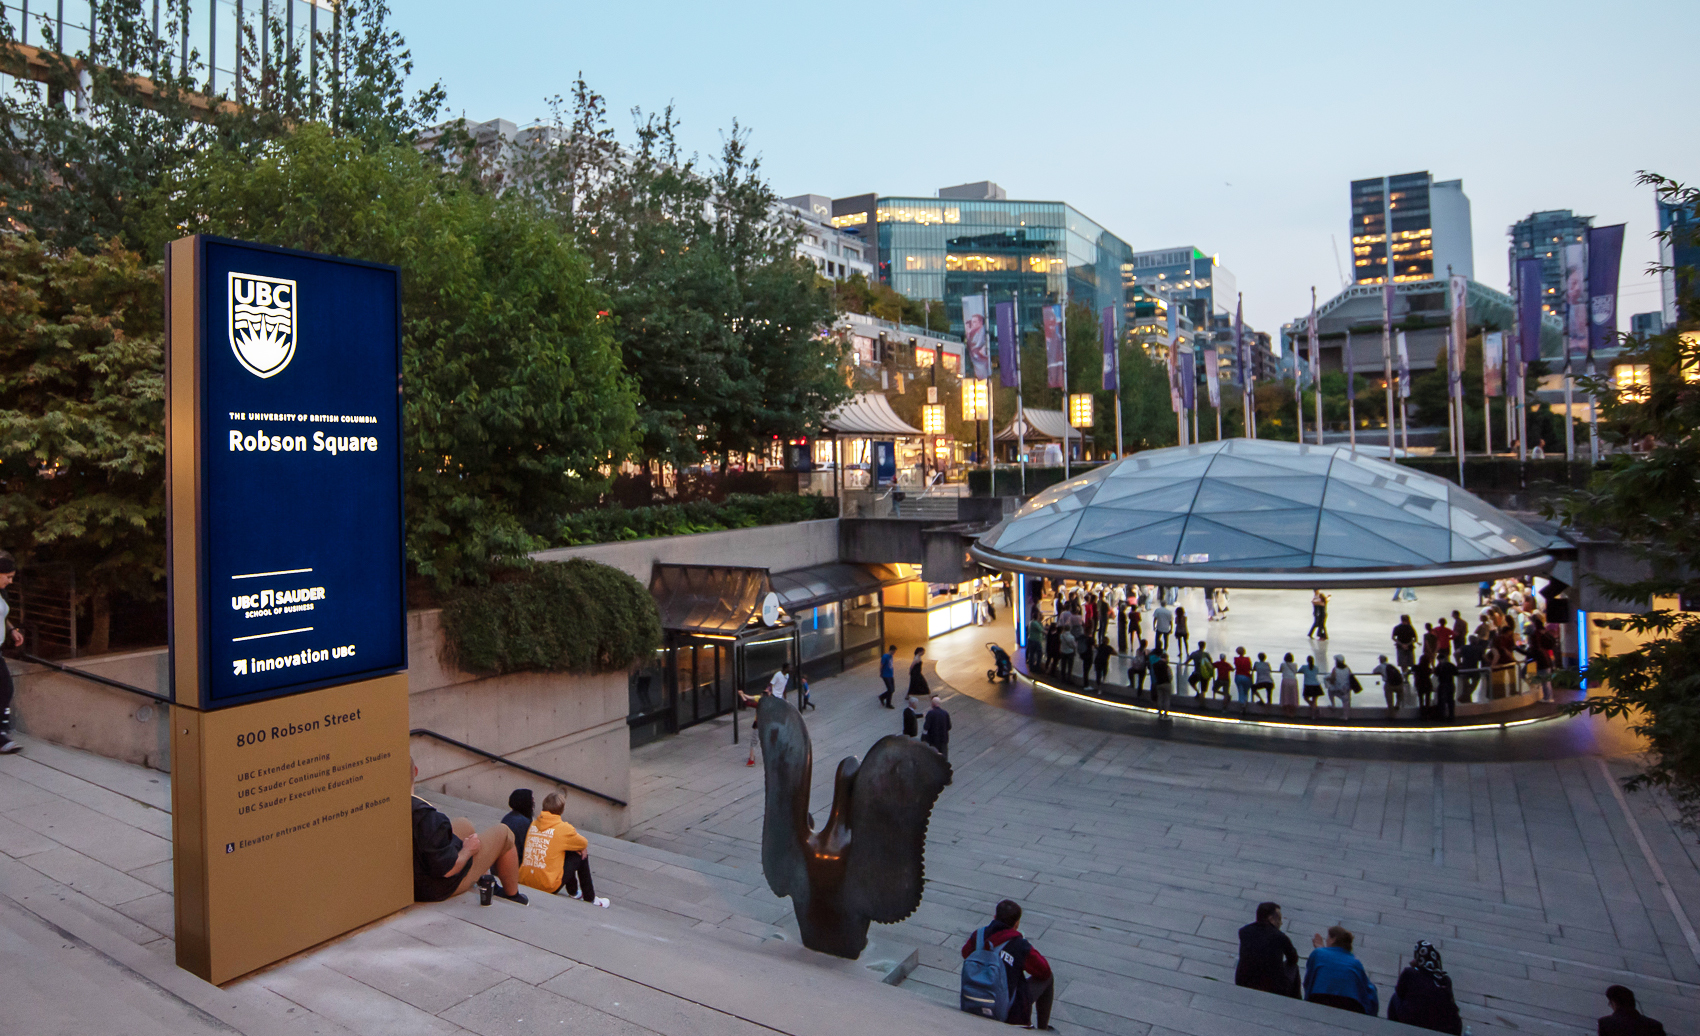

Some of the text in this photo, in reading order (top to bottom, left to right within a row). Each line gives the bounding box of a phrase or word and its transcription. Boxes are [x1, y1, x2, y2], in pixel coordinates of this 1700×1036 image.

[234, 278, 291, 309] UBC
[229, 412, 378, 424] THE UNIVERSITY OF BRITISH COLUMBIA
[229, 430, 378, 456] Robson Square
[232, 586, 326, 611] UBC SAUDER
[244, 603, 315, 619] SCHOOL OF BUSINESS
[251, 644, 356, 674] innovation UBC
[236, 708, 361, 747] 800 Robson Street
[237, 753, 330, 781] UBC Extended Learning
[238, 752, 391, 798] UBC Sauder Continuing Business Studies
[238, 774, 364, 815] UBC Sauder Executive Education
[239, 797, 391, 848] Elevator entrance at Hornby and Robson
